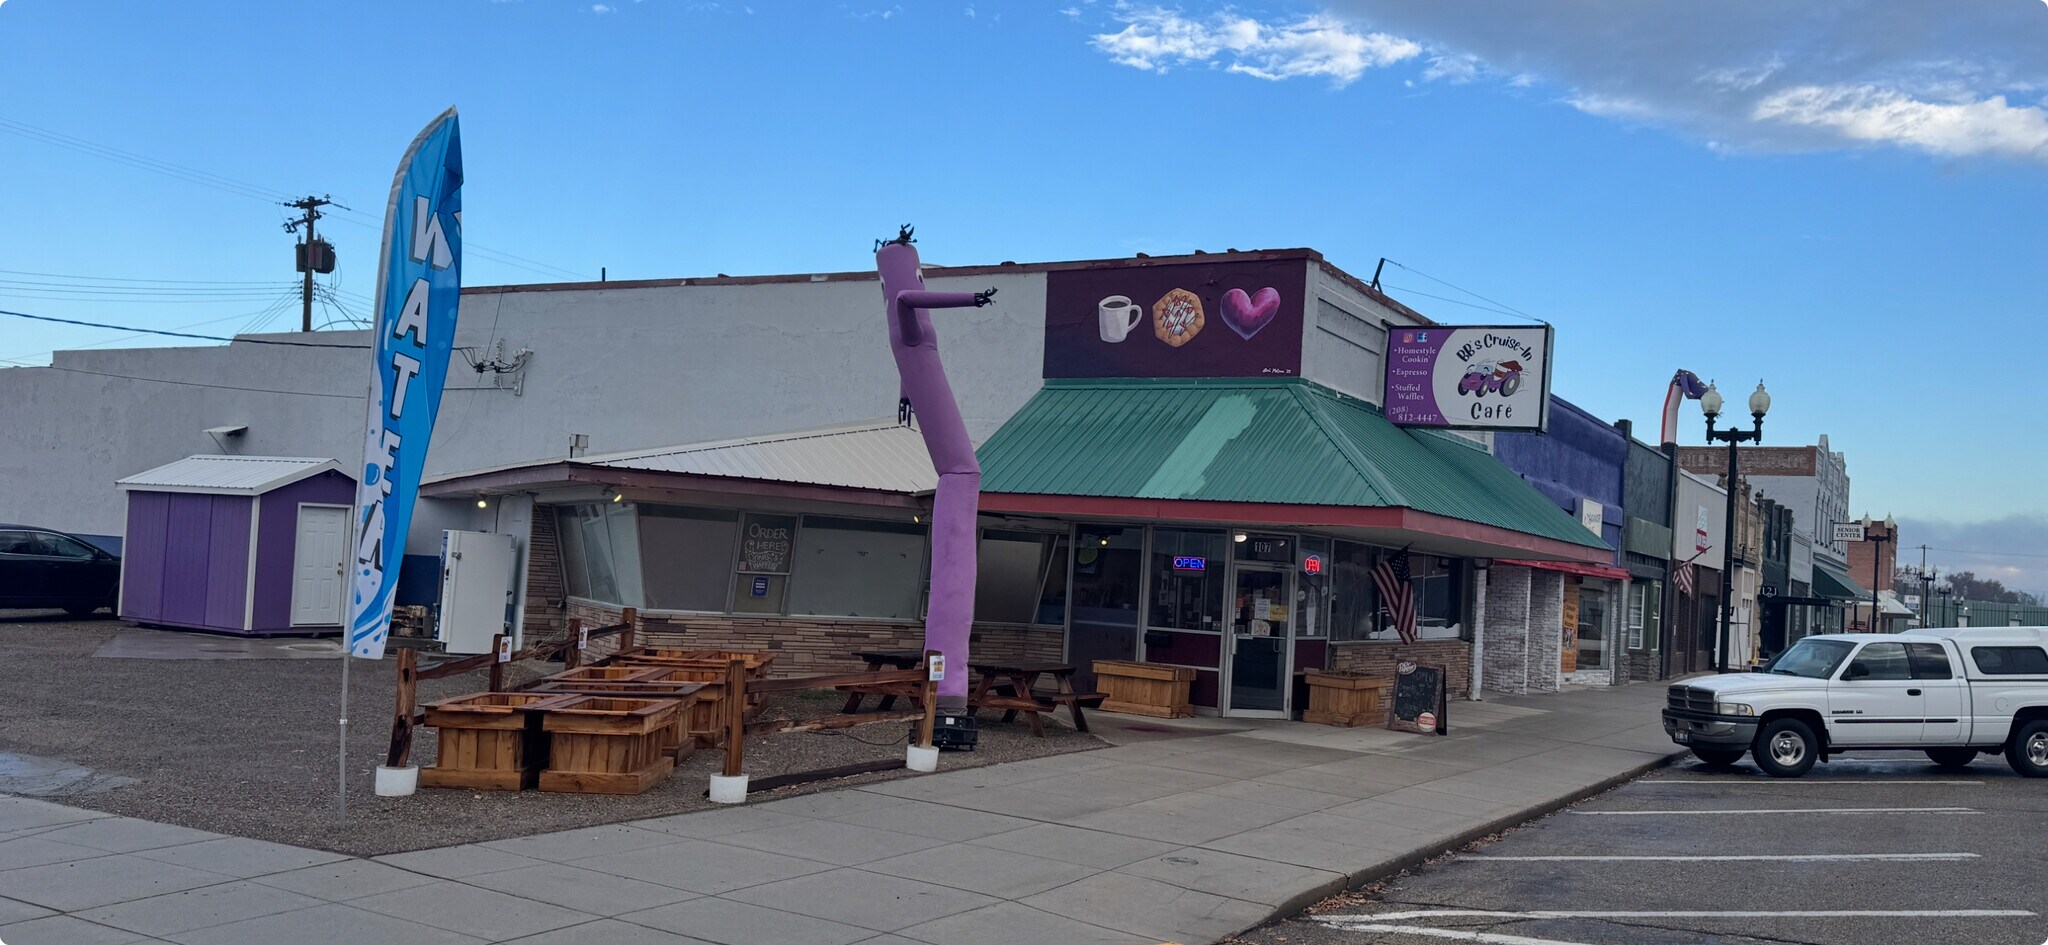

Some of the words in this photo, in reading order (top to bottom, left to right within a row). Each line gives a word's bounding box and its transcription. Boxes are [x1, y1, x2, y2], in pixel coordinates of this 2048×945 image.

[1397, 346, 1437, 356] Homestyle
[1456, 340, 1483, 362] BB's
[1484, 333, 1533, 361] Cruise-In
[1402, 355, 1431, 363] Cookin'
[1396, 368, 1428, 378] Espresso
[1395, 383, 1421, 392] Stuffed
[1397, 392, 1425, 400] Waffles
[1388, 405, 1409, 415] (208)
[1471, 402, 1513, 419] Café
[1397, 413, 1438, 422] 812-4447
[749, 523, 788, 539] ORDER
[1254, 541, 1272, 553] 107
[1174, 558, 1205, 568] OPEN
[1304, 558, 1320, 572] OPEN
